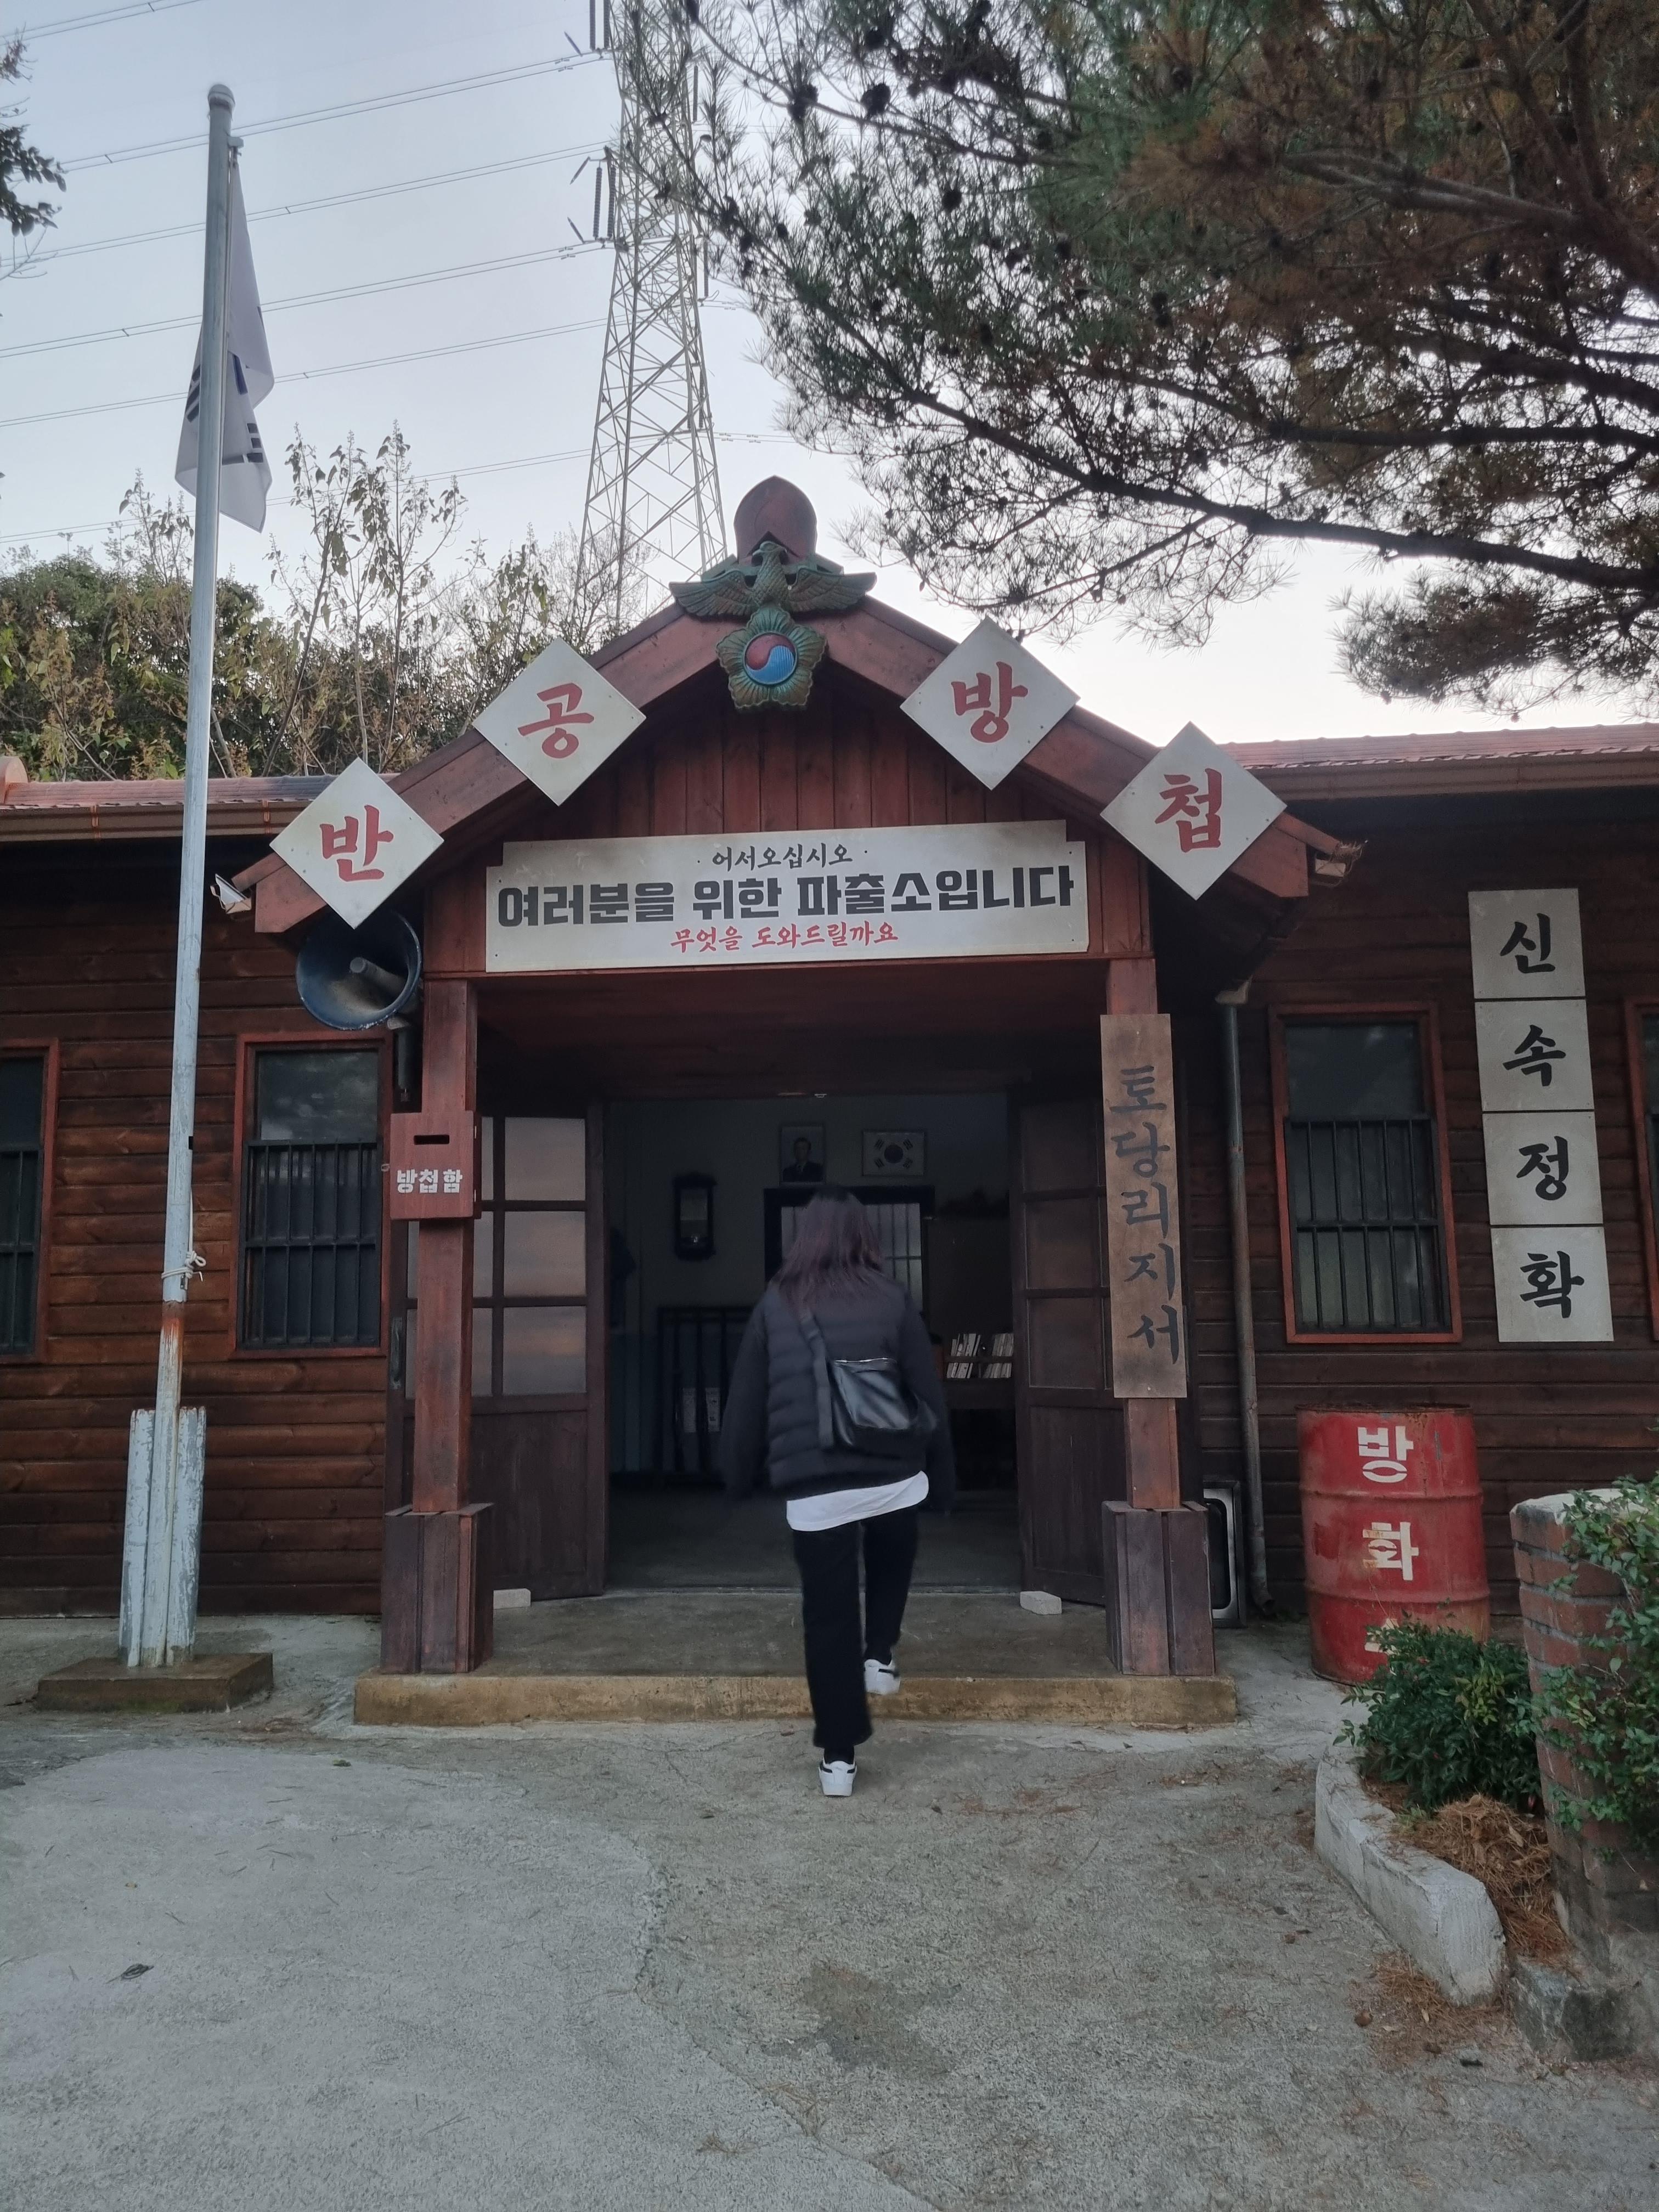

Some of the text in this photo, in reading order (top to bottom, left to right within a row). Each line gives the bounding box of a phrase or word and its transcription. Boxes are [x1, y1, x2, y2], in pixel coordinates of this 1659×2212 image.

[320, 661, 1222, 882] 반 공 방 첩
[712, 843, 853, 872] 어서오십시오
[498, 865, 1075, 927] 여러분을 위한 파출소입니다
[670, 920, 899, 953] 무엇을 도와드릴까요
[397, 1169, 462, 1193] 방첩함
[1110, 1065, 1179, 1364] 토당리지서
[1358, 1425, 1420, 1656] 방화
